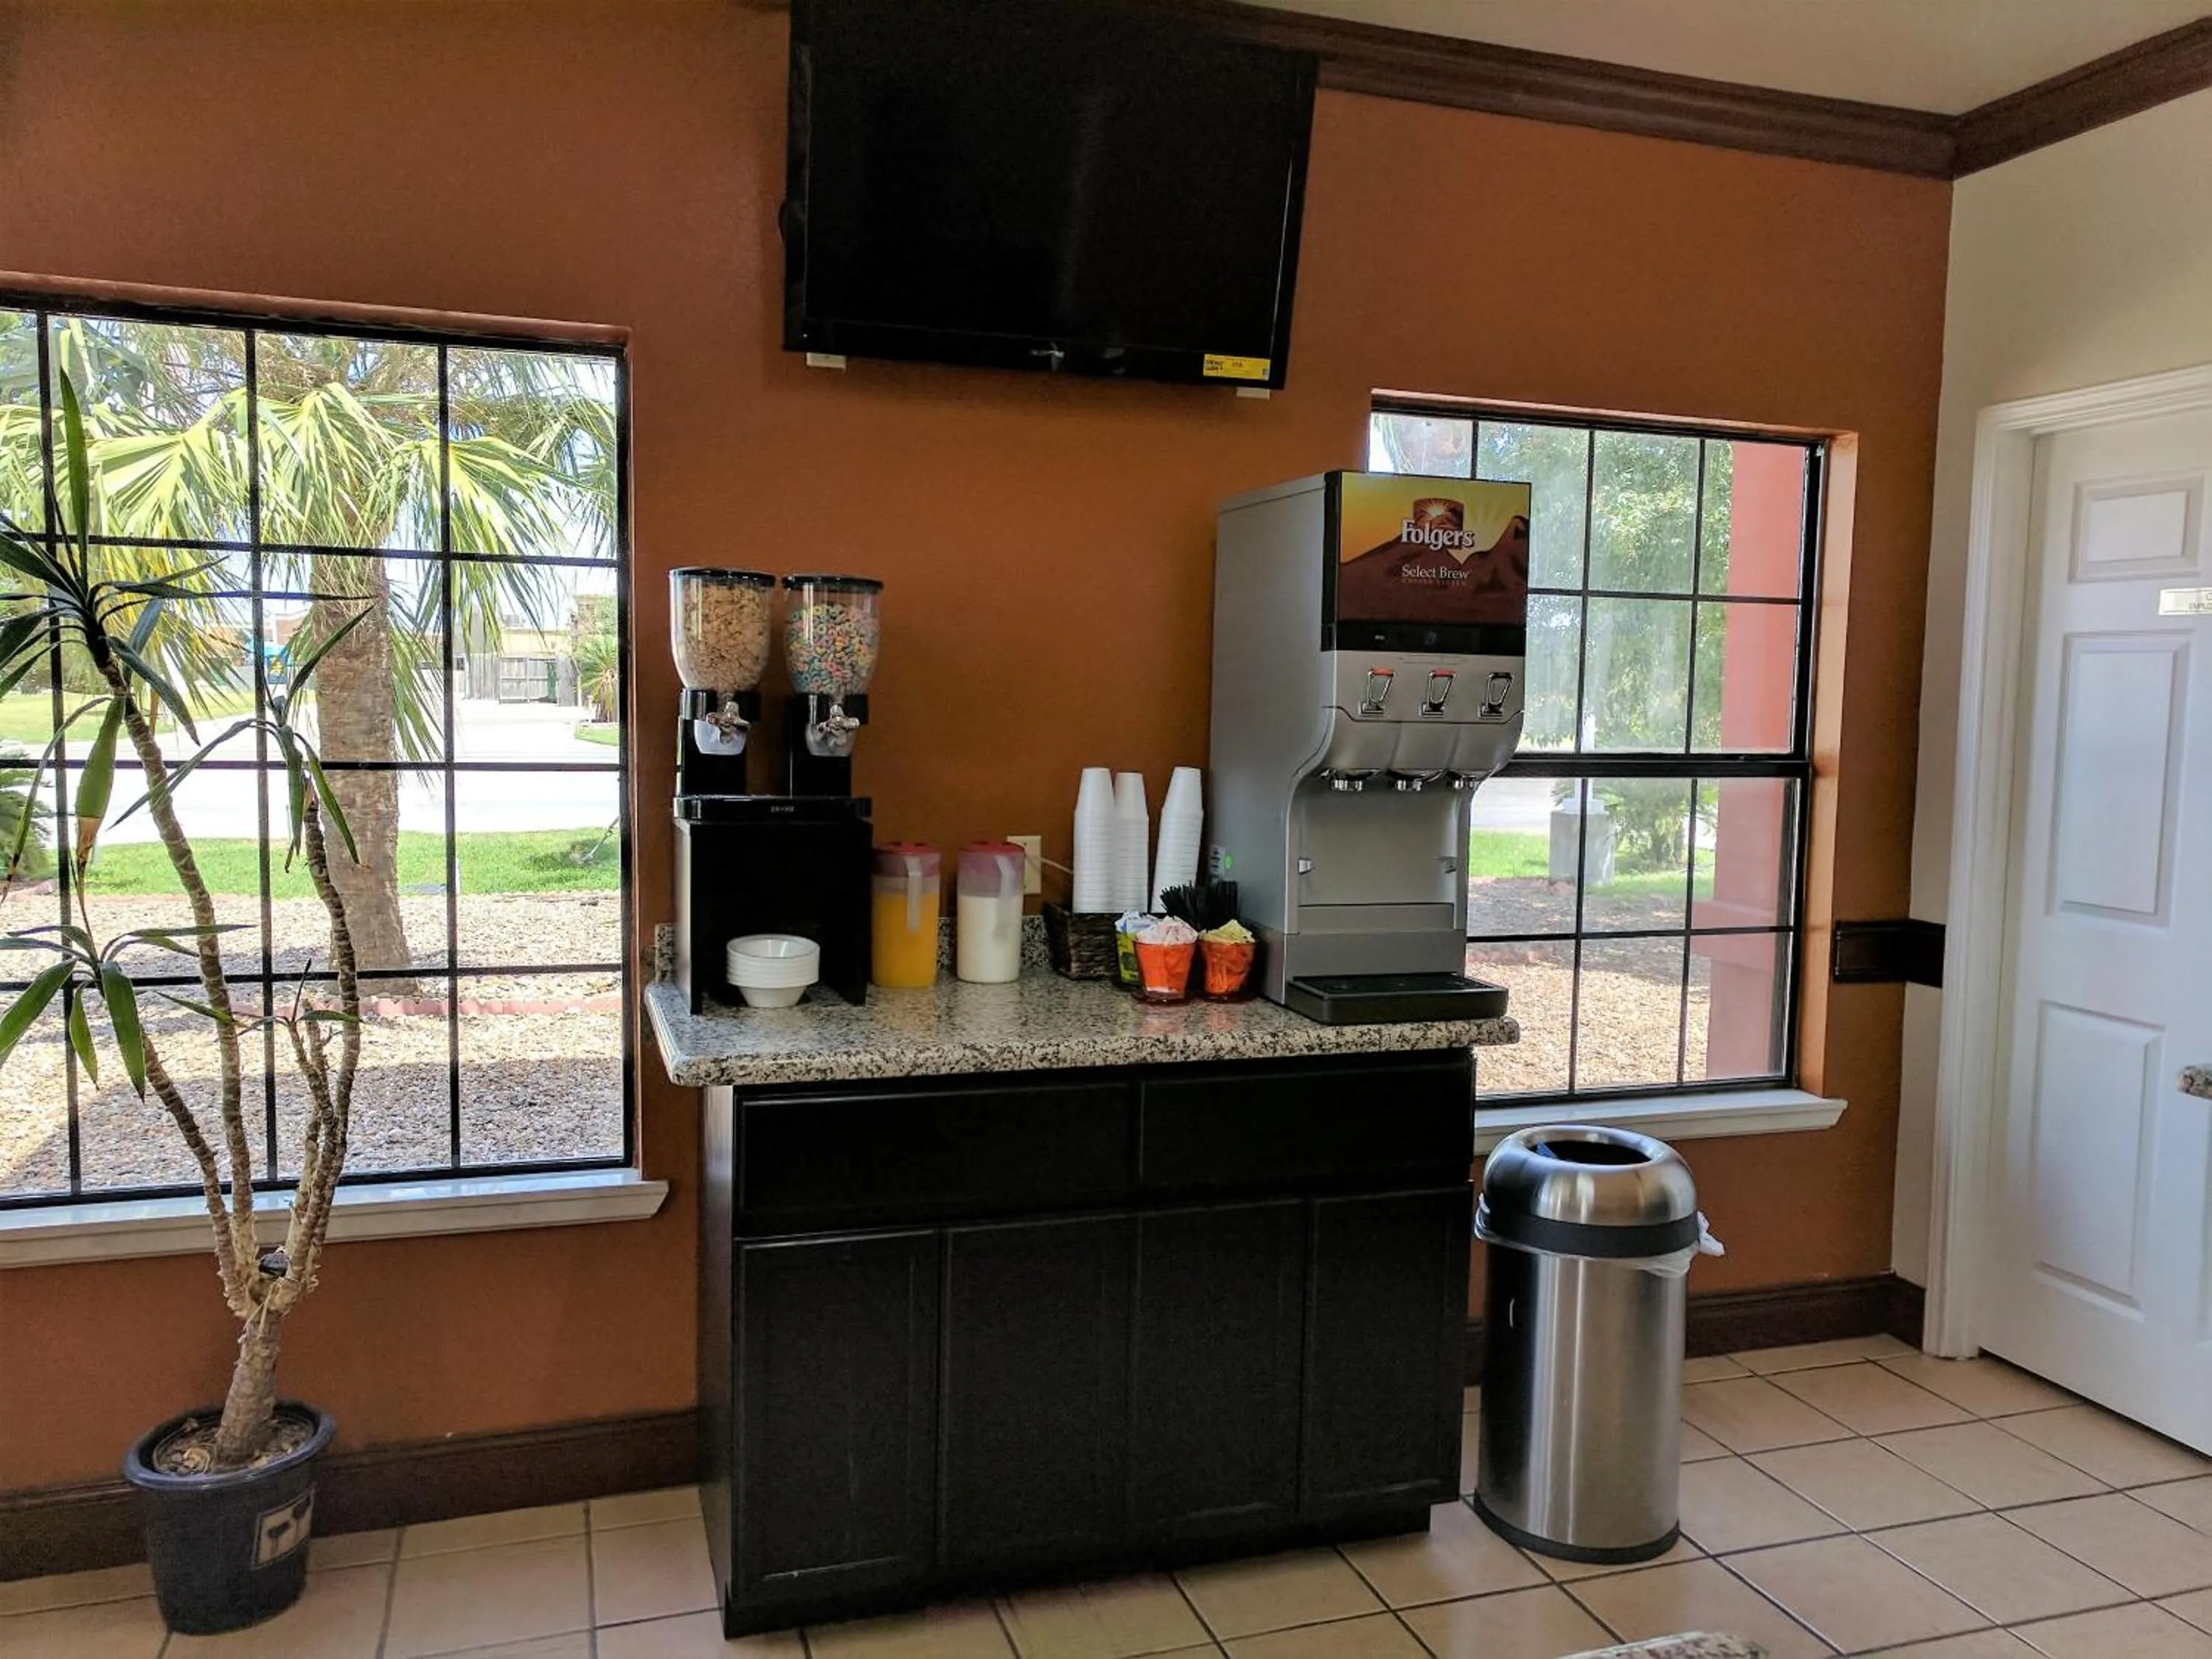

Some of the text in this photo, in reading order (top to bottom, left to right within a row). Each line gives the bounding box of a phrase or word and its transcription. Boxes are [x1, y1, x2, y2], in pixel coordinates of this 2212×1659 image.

[1401, 518, 1474, 550] Folgers
[1402, 564, 1470, 579] Select Brew
